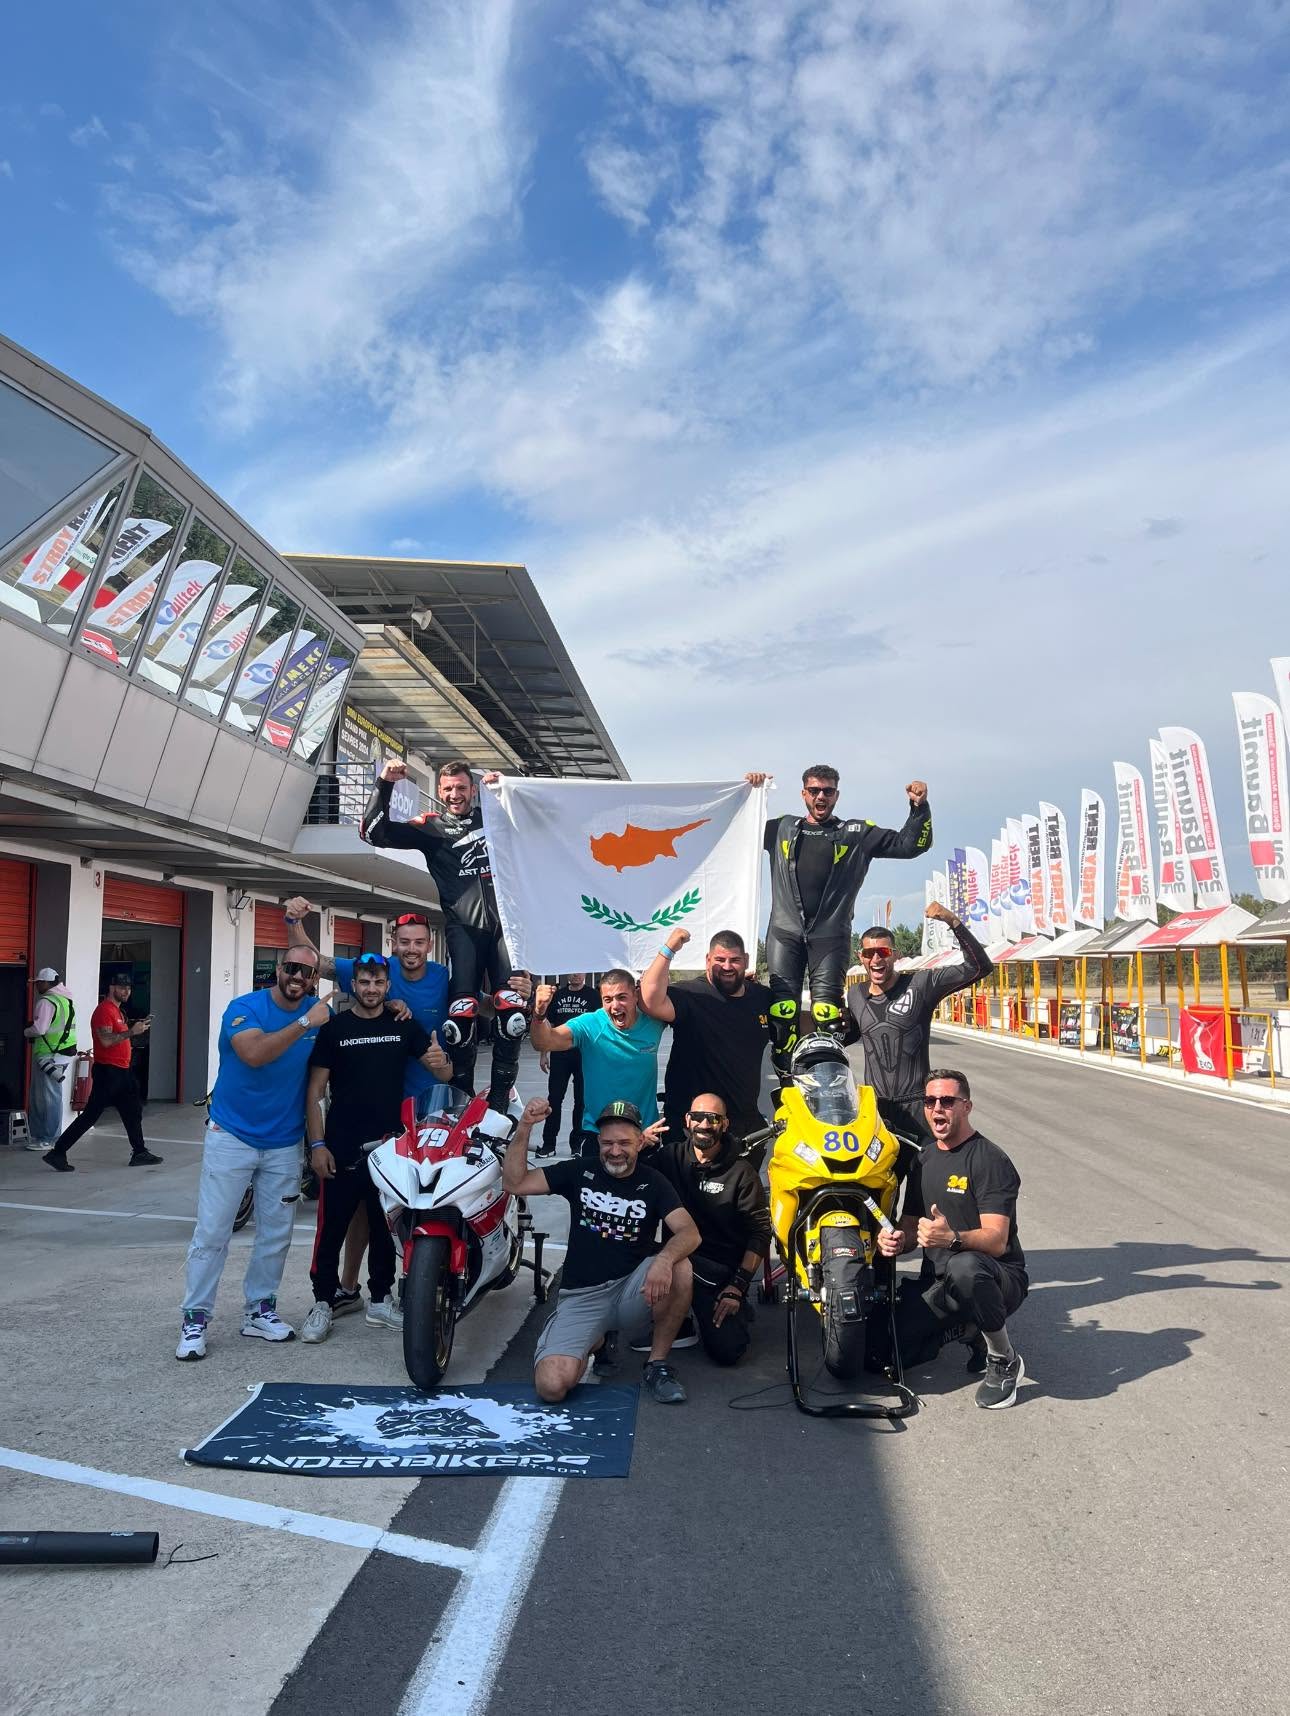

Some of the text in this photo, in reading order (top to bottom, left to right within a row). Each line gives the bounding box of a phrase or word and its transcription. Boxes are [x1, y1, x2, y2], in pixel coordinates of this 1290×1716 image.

[344, 718, 368, 741] GRAND PRIX
[357, 714, 377, 736] EUROPEAN
[341, 729, 369, 755] SERRES 2024
[95, 871, 101, 888] 3
[459, 866, 492, 876] ASTAR
[557, 996, 587, 1006] INDIAN
[340, 1035, 401, 1047] UNDERBIKERS
[824, 1131, 860, 1152] 80
[475, 1154, 495, 1169] YAMAHA
[947, 1174, 968, 1190] 34
[580, 1187, 647, 1219] astars
